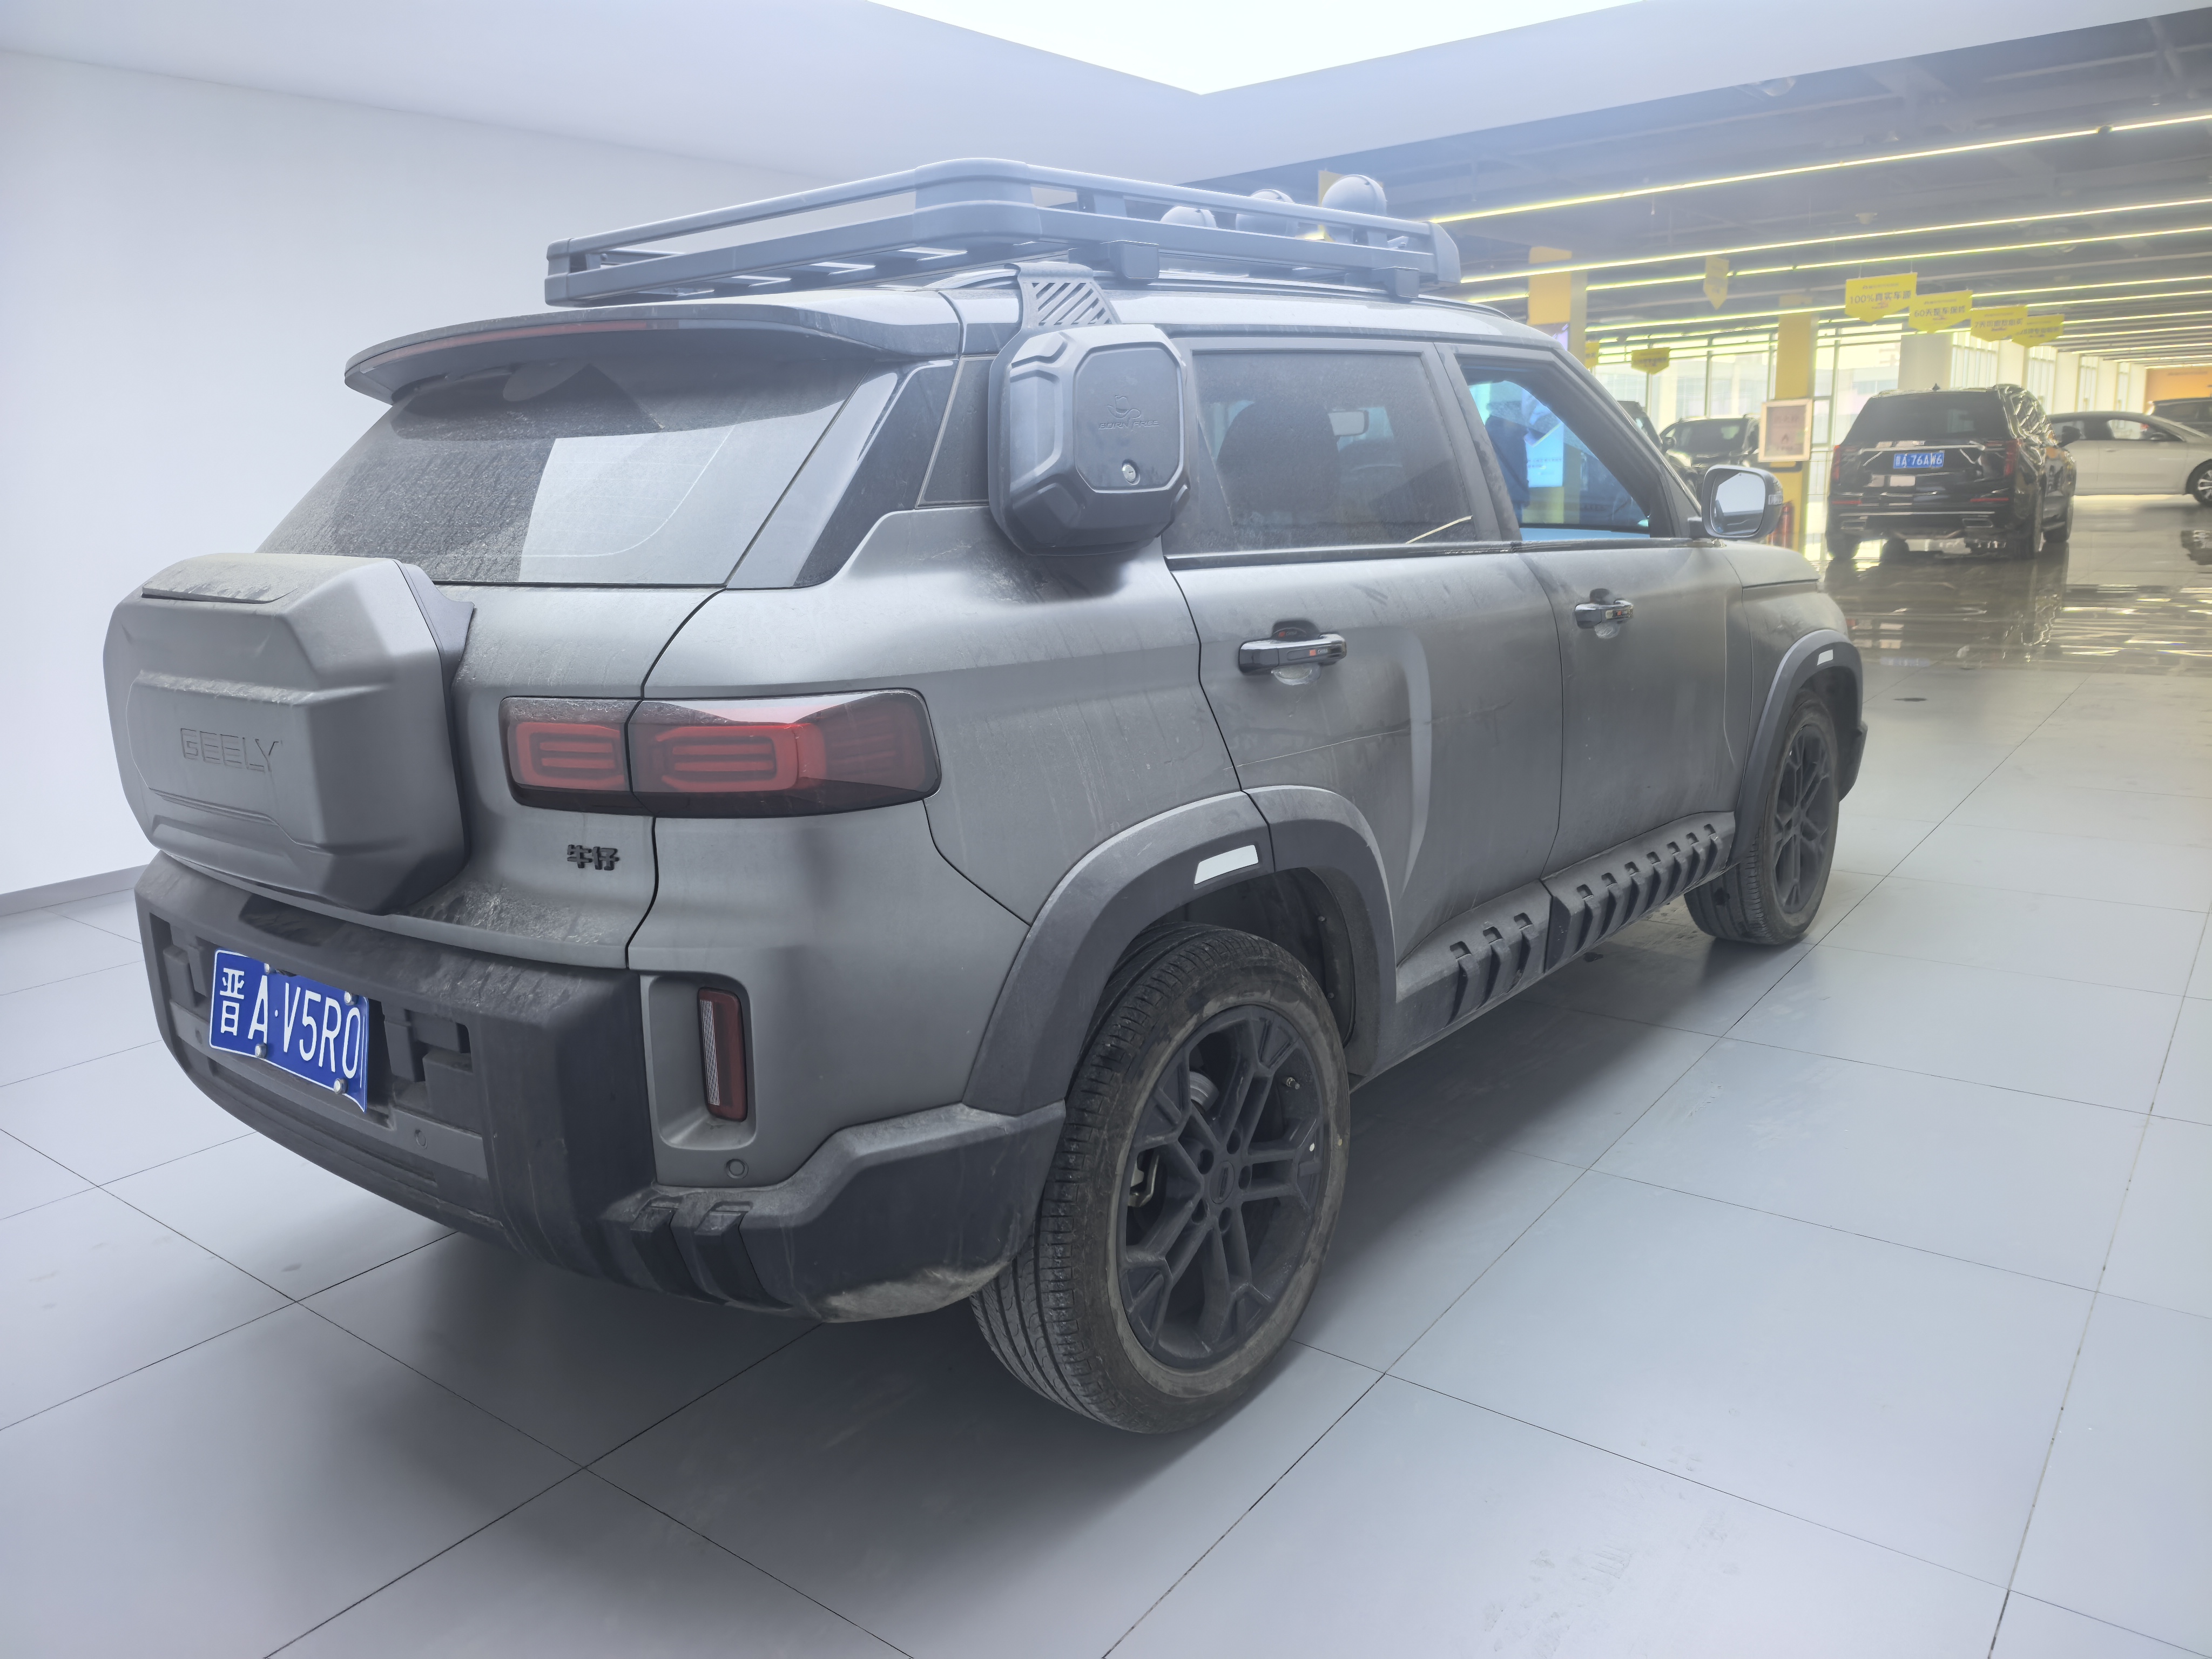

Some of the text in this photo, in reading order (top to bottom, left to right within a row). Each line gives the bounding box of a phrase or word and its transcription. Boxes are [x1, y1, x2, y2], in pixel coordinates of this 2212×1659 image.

[1132, 420, 1160, 429] FREE
[180, 728, 280, 773] GEELY
[567, 845, 619, 871] 牛仔
[219, 968, 365, 1089] 晋A·V5R0
